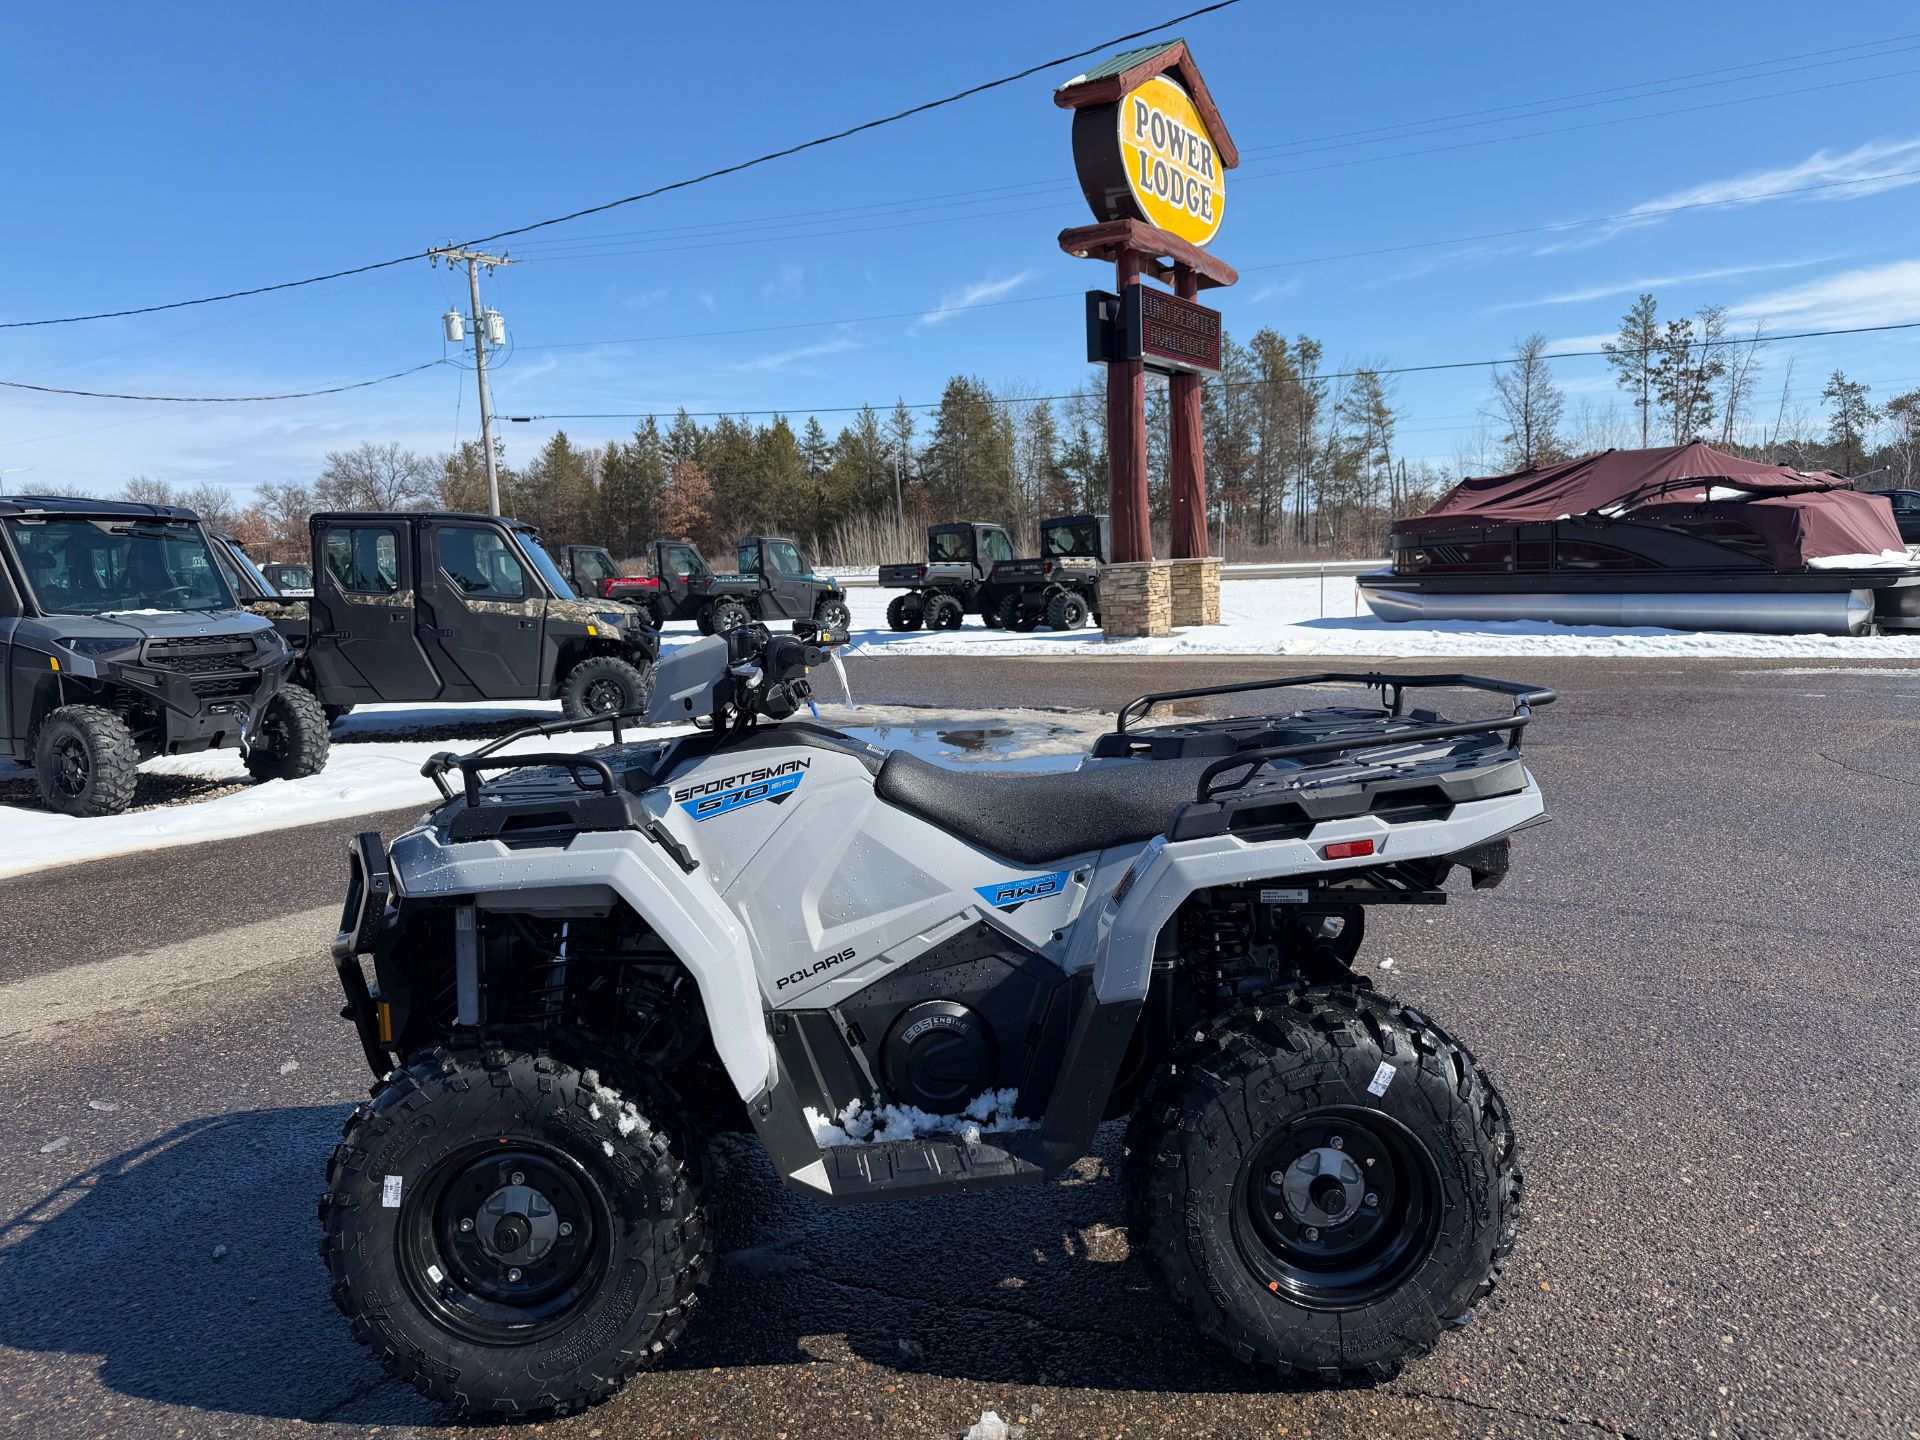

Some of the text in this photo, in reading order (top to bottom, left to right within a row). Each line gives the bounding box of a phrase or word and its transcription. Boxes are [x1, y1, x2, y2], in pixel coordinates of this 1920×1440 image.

[1134, 98, 1214, 181] POWER
[1139, 150, 1212, 221] LODGE
[1142, 294, 1217, 336] LUND REBATES
[674, 757, 811, 802] SPORTSMAN
[697, 784, 768, 814] 570
[996, 881, 1056, 902] AWD
[776, 947, 856, 990] POLARIS
[904, 1016, 969, 1042] EBS ENGINE
